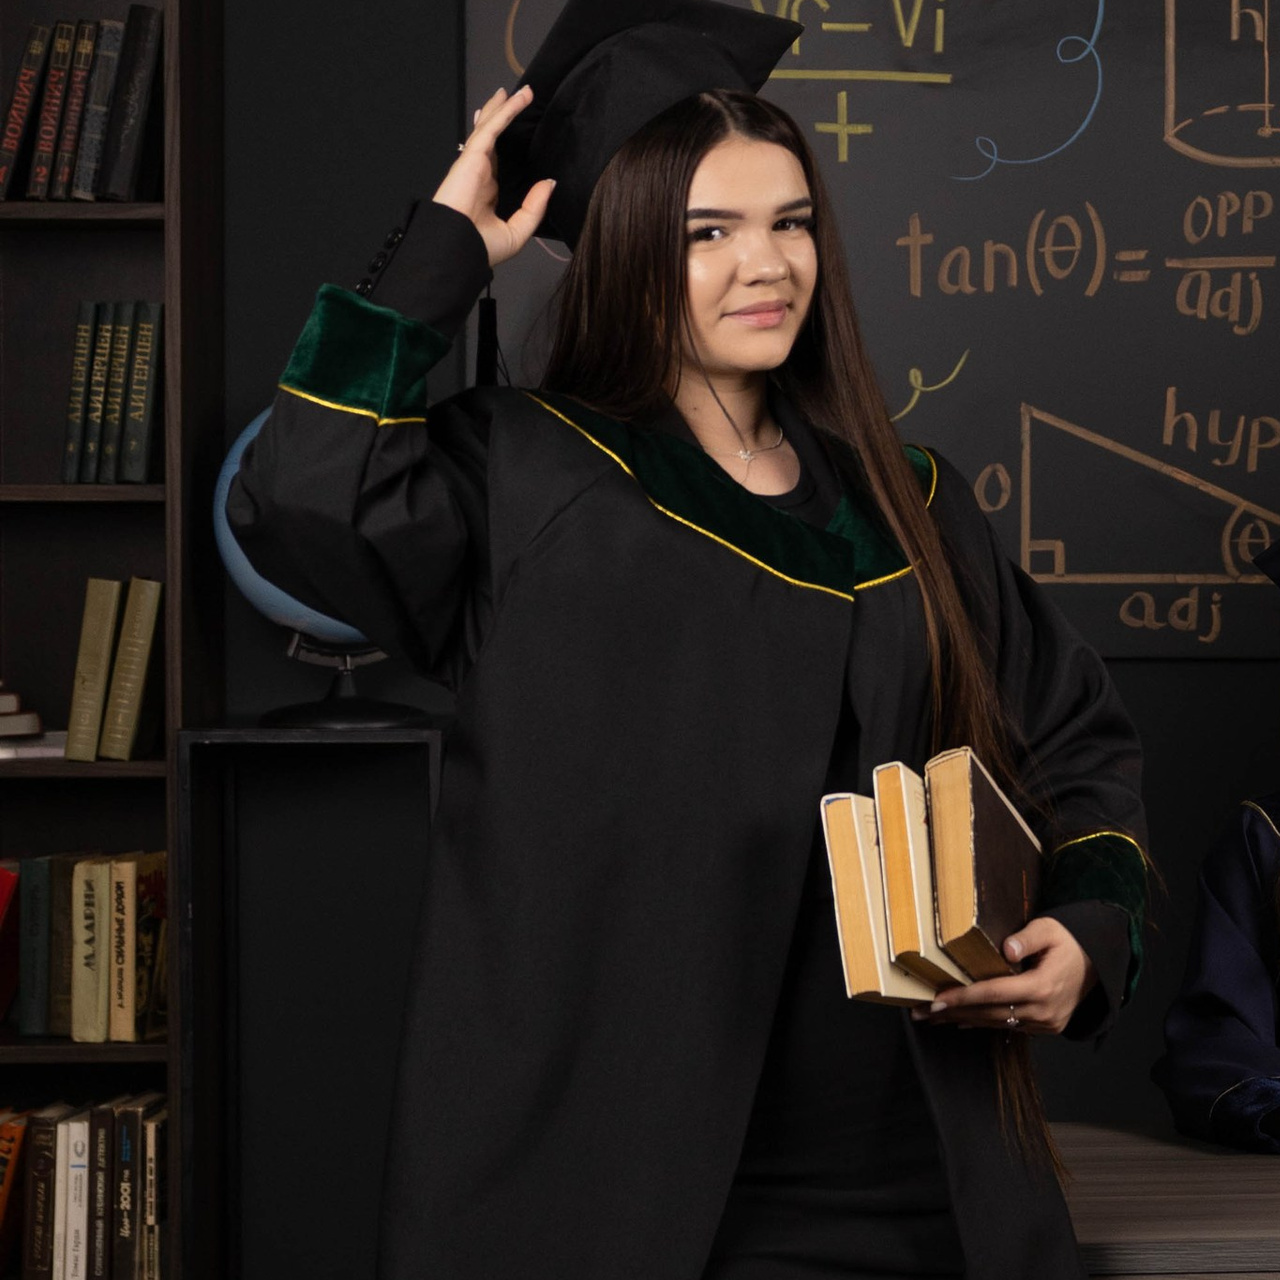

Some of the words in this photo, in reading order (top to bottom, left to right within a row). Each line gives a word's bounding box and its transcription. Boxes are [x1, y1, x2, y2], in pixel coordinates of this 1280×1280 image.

[2, 67, 38, 152] ВОЙНИЧ
[38, 67, 66, 153] ВОЙНИЧ
[1118, 588, 1223, 643] adj
[119, 1181, 132, 1211] 2001
